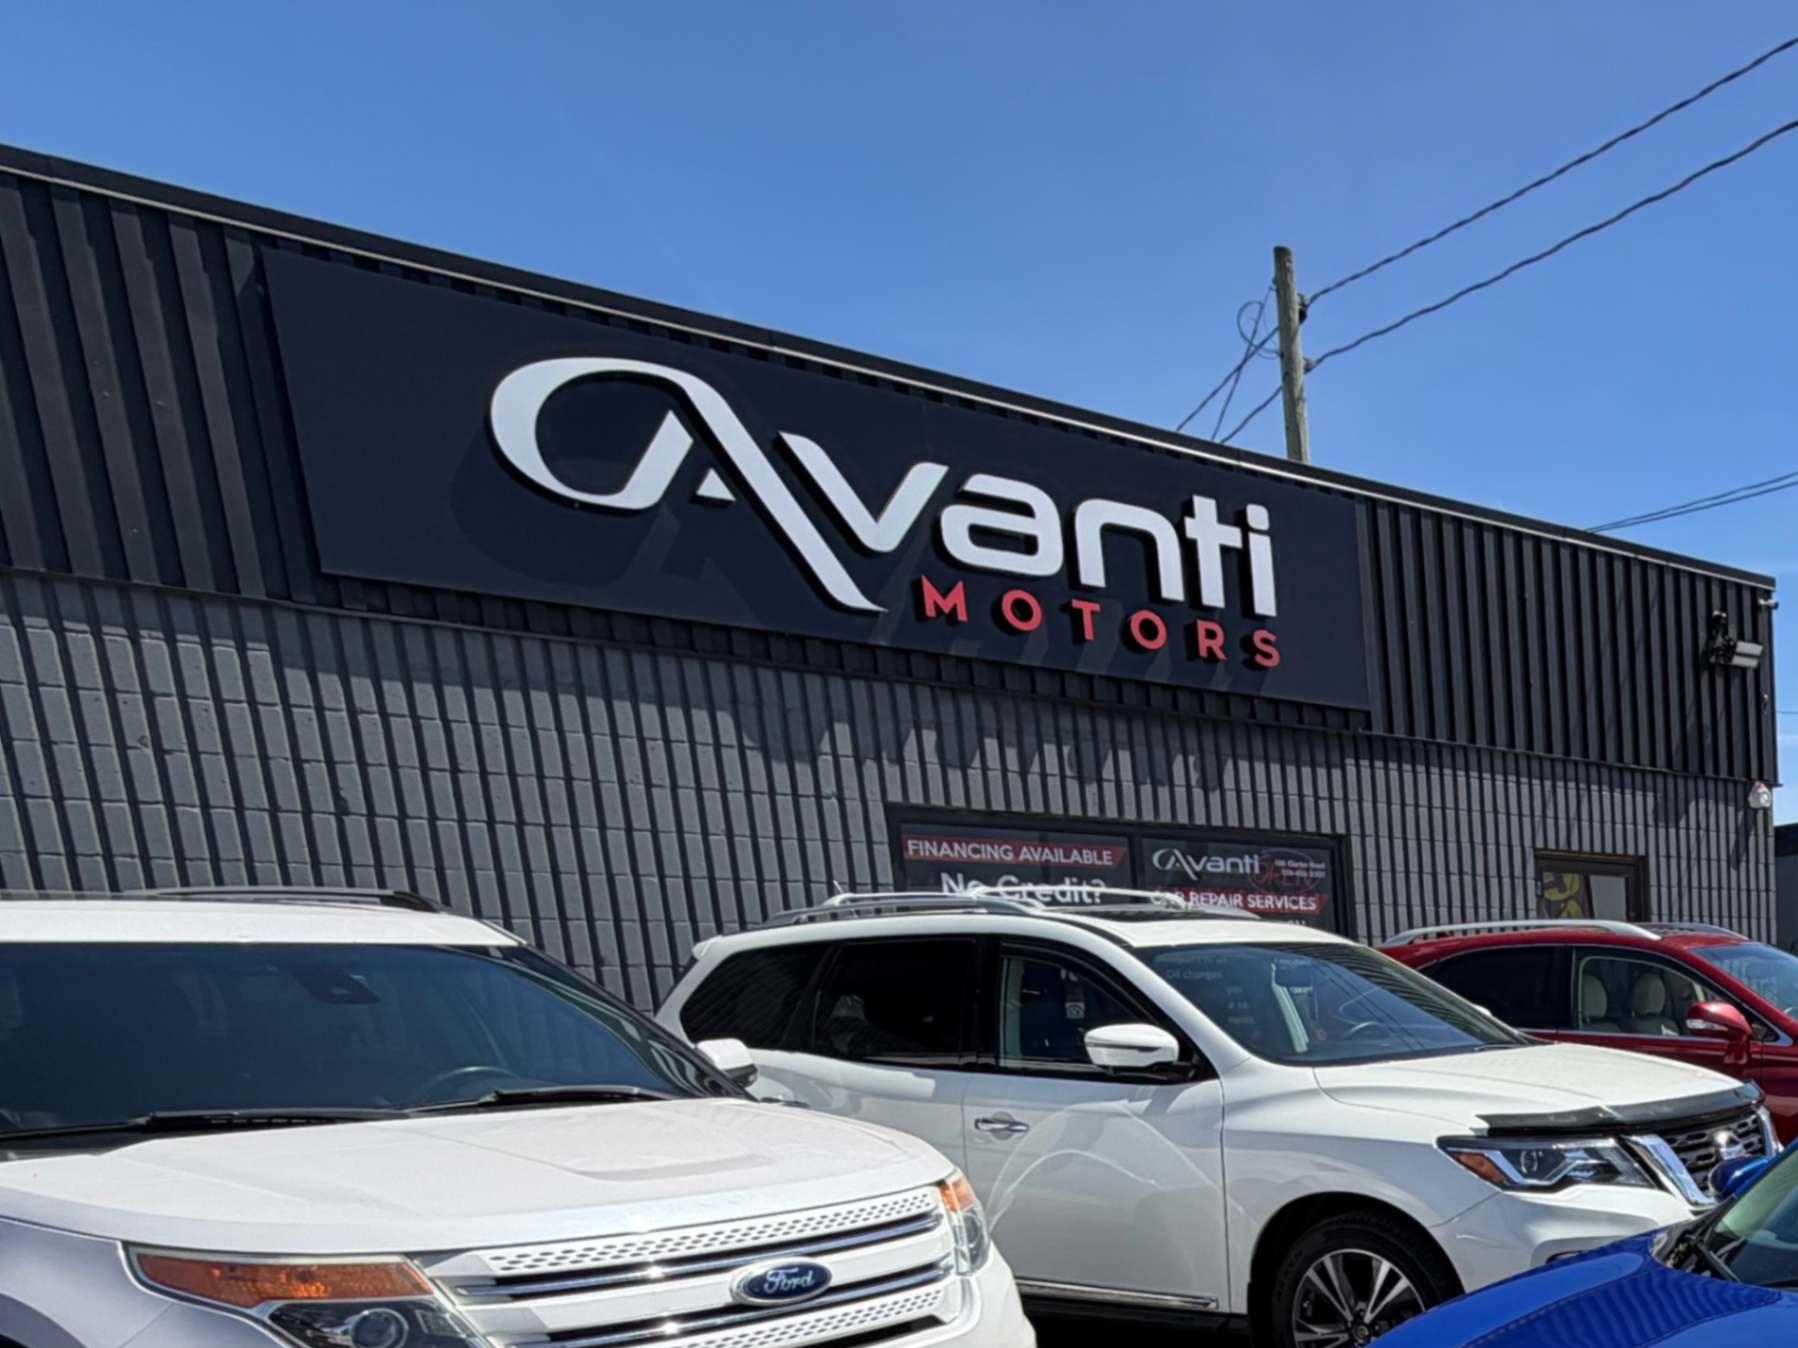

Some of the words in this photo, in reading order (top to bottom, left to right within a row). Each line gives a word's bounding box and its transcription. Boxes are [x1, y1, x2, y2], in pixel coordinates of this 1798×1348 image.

[490, 356, 1277, 617] Avanti
[922, 575, 1280, 668] MOTORS
[907, 839, 1014, 862] FINANCING
[1019, 846, 1113, 866] AVAILABLE
[1152, 848, 1260, 881] Avanti
[1190, 891, 1243, 908] REPAIR
[1247, 893, 1318, 911] SERVICES
[763, 1266, 816, 1294] Ford
